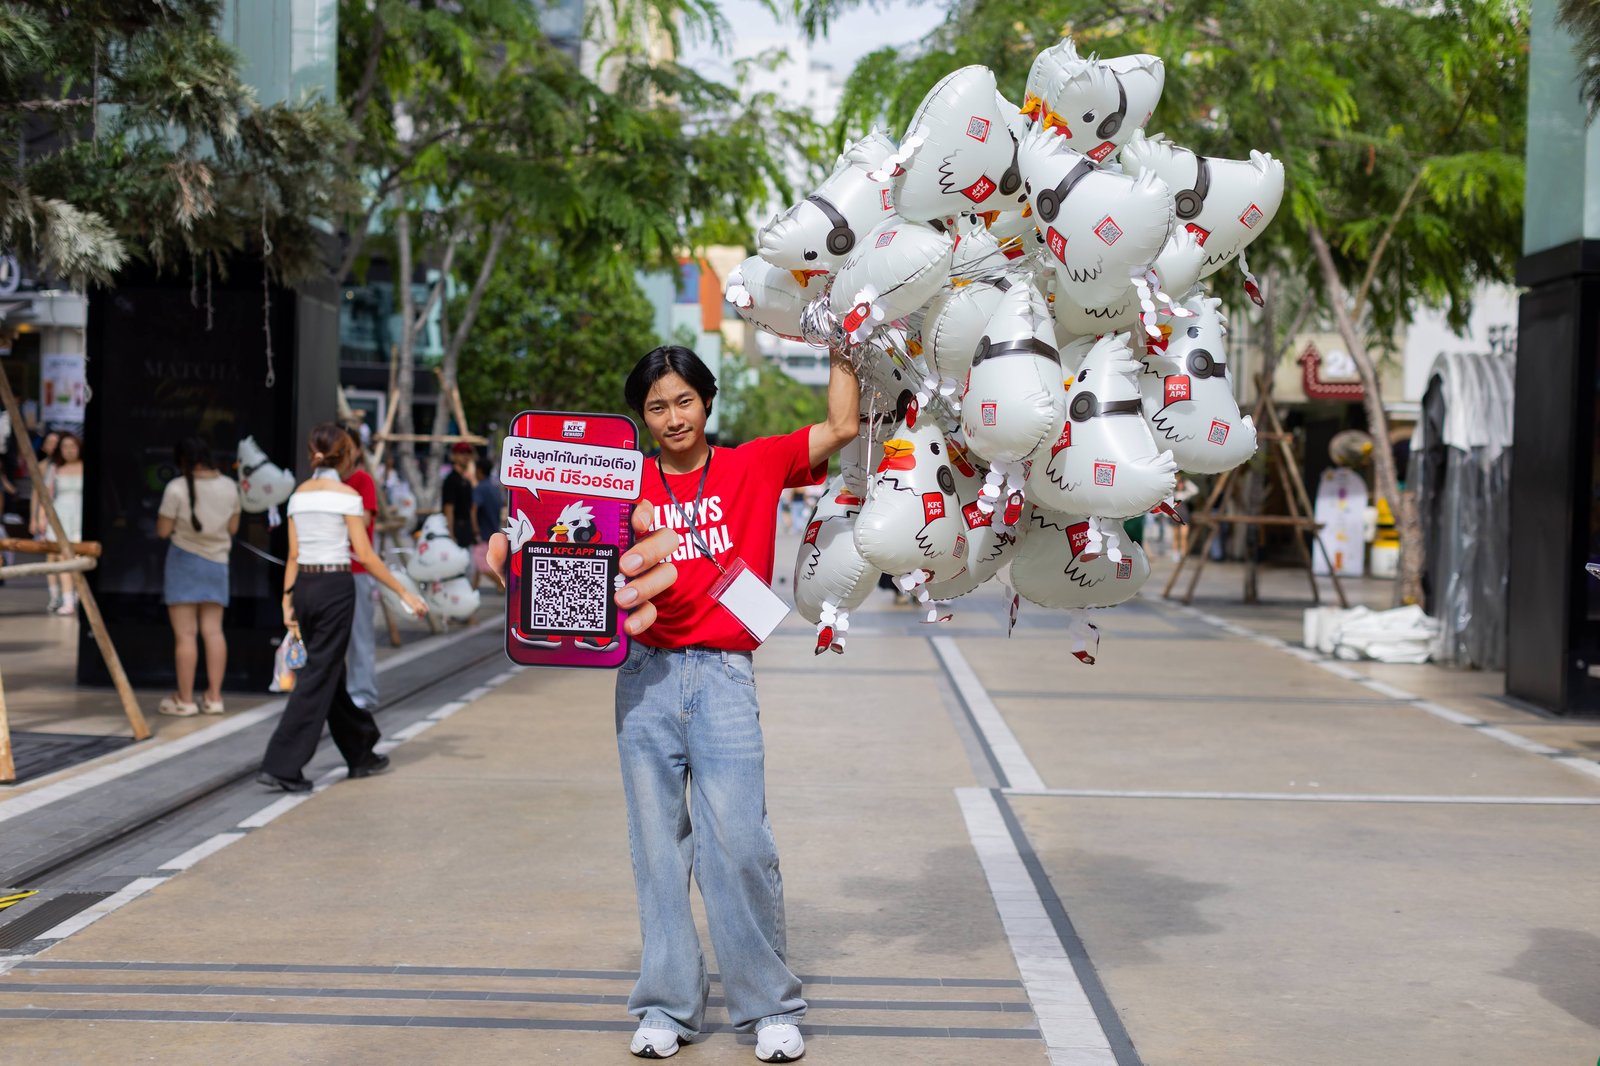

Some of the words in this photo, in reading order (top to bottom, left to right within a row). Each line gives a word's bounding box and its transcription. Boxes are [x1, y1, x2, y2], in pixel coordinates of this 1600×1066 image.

[971, 180, 985, 196] APP
[974, 182, 990, 200] KFC
[1050, 233, 1059, 251] KFC
[1055, 239, 1063, 255] APP
[1168, 383, 1187, 391] KFC
[509, 443, 636, 471] เลี้ยงลูกไก่ในกำมือ(ถือ)
[508, 460, 556, 482] เลี้ยงดี
[560, 469, 635, 491] มีรีวอร์ดส
[648, 495, 723, 532] LWAYS
[552, 547, 574, 555] KFC
